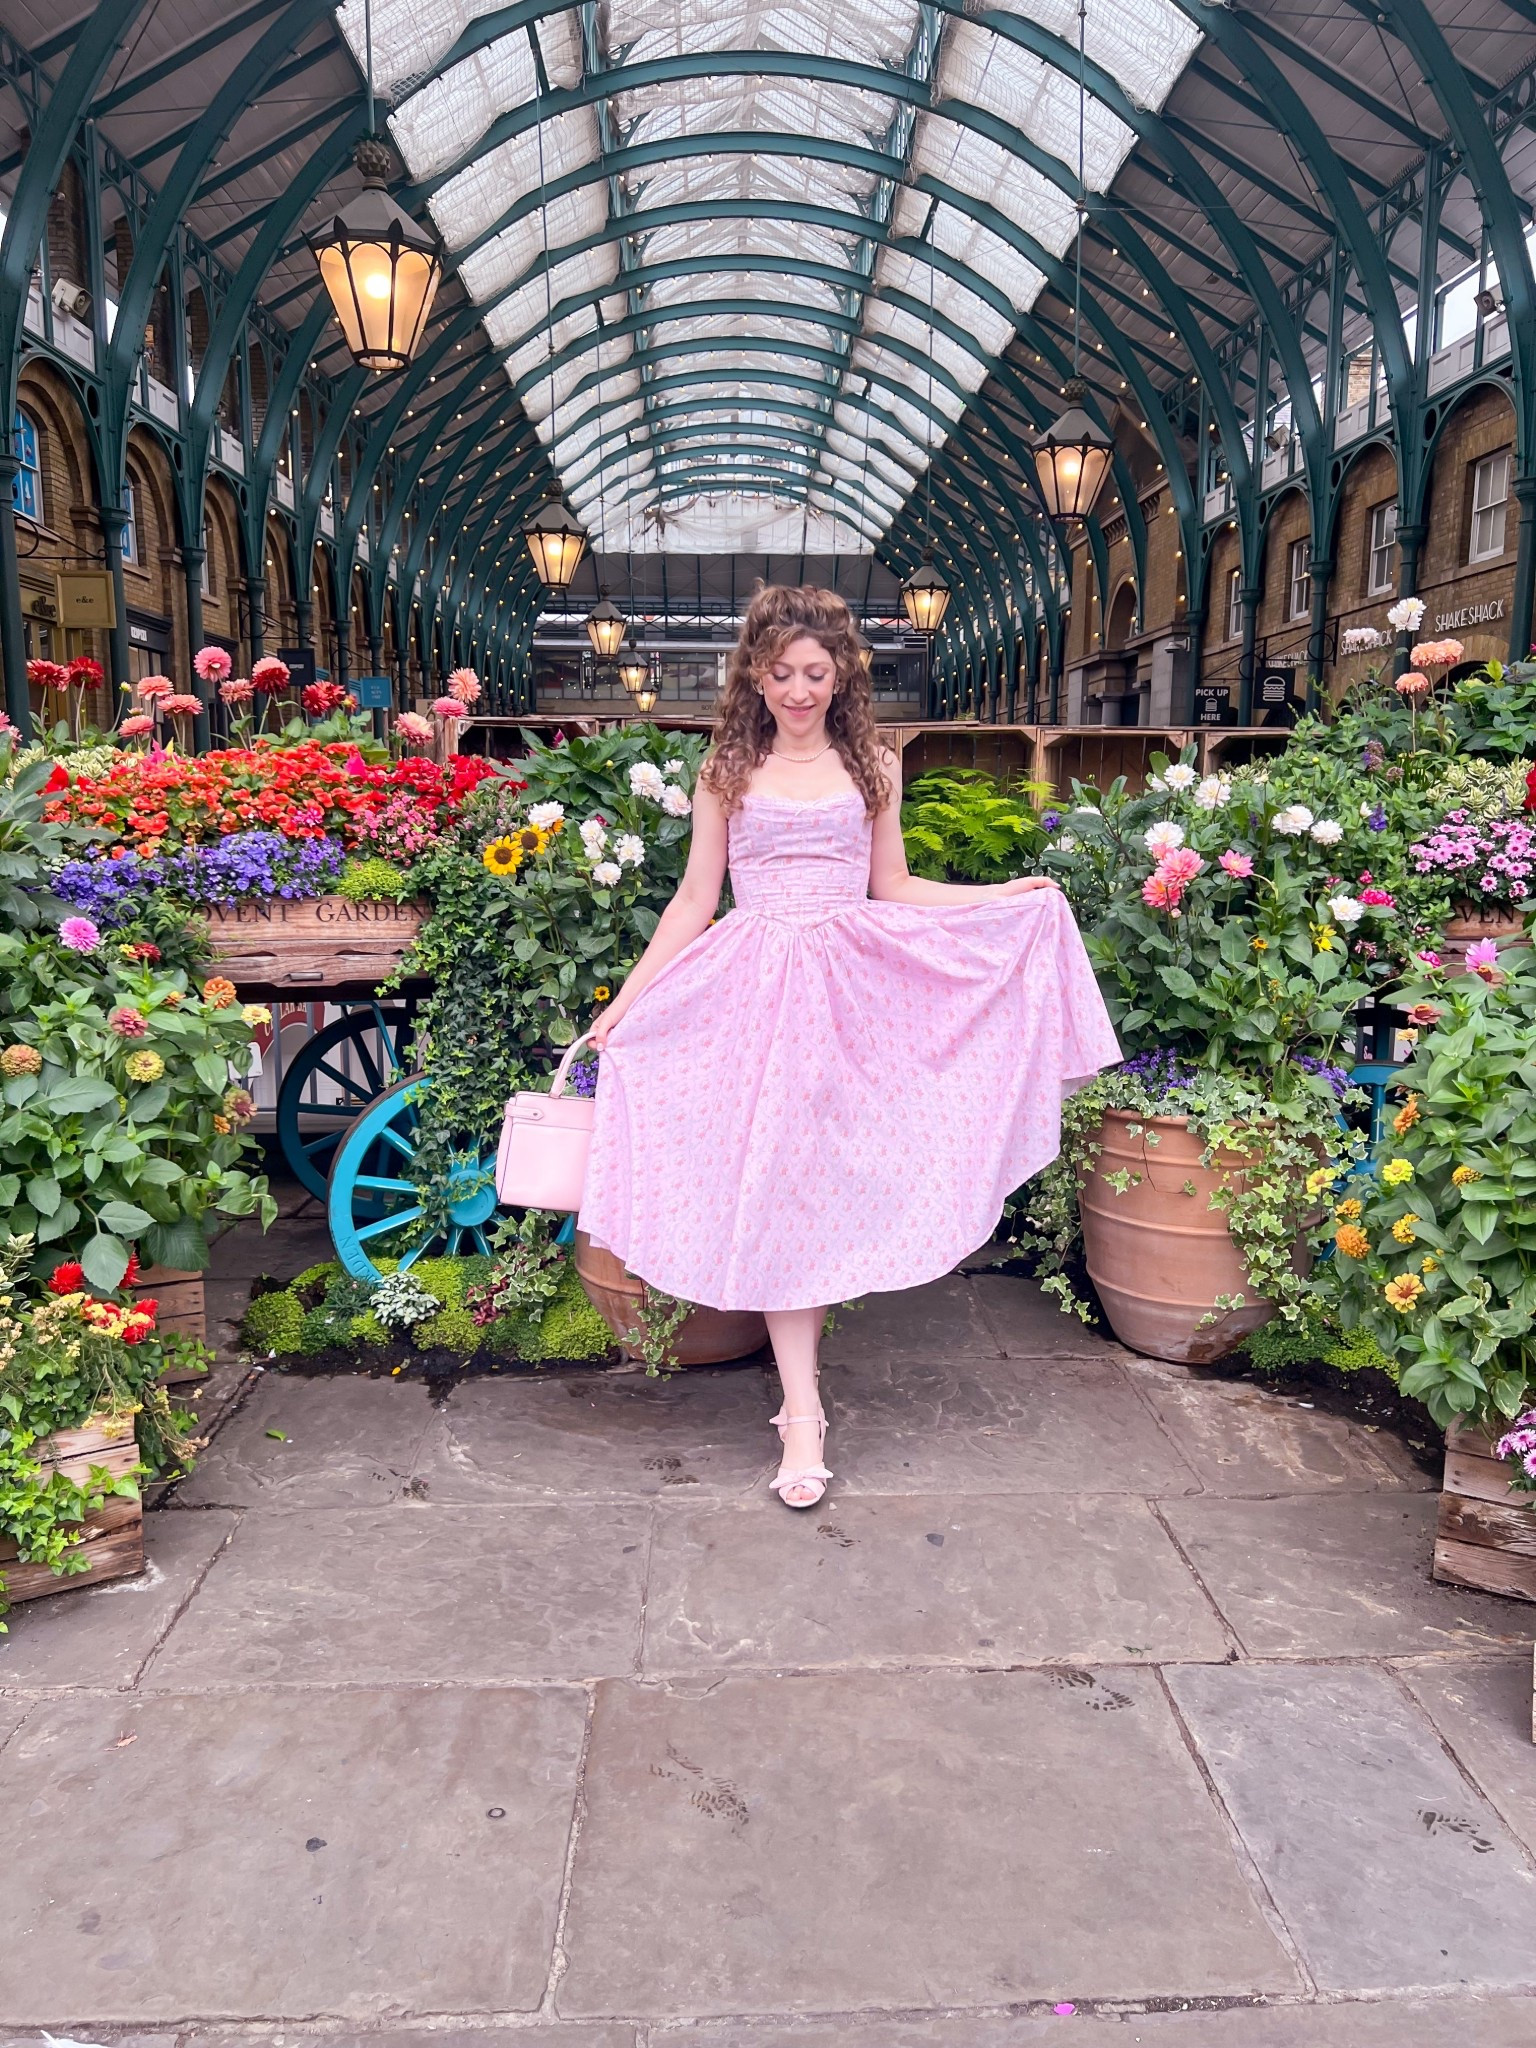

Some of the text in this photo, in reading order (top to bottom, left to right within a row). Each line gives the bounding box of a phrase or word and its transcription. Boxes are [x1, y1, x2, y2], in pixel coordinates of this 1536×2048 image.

[1195, 688, 1229, 697] PICK UP
[1200, 713, 1221, 721] HERE
[190, 902, 294, 923] OVENT
